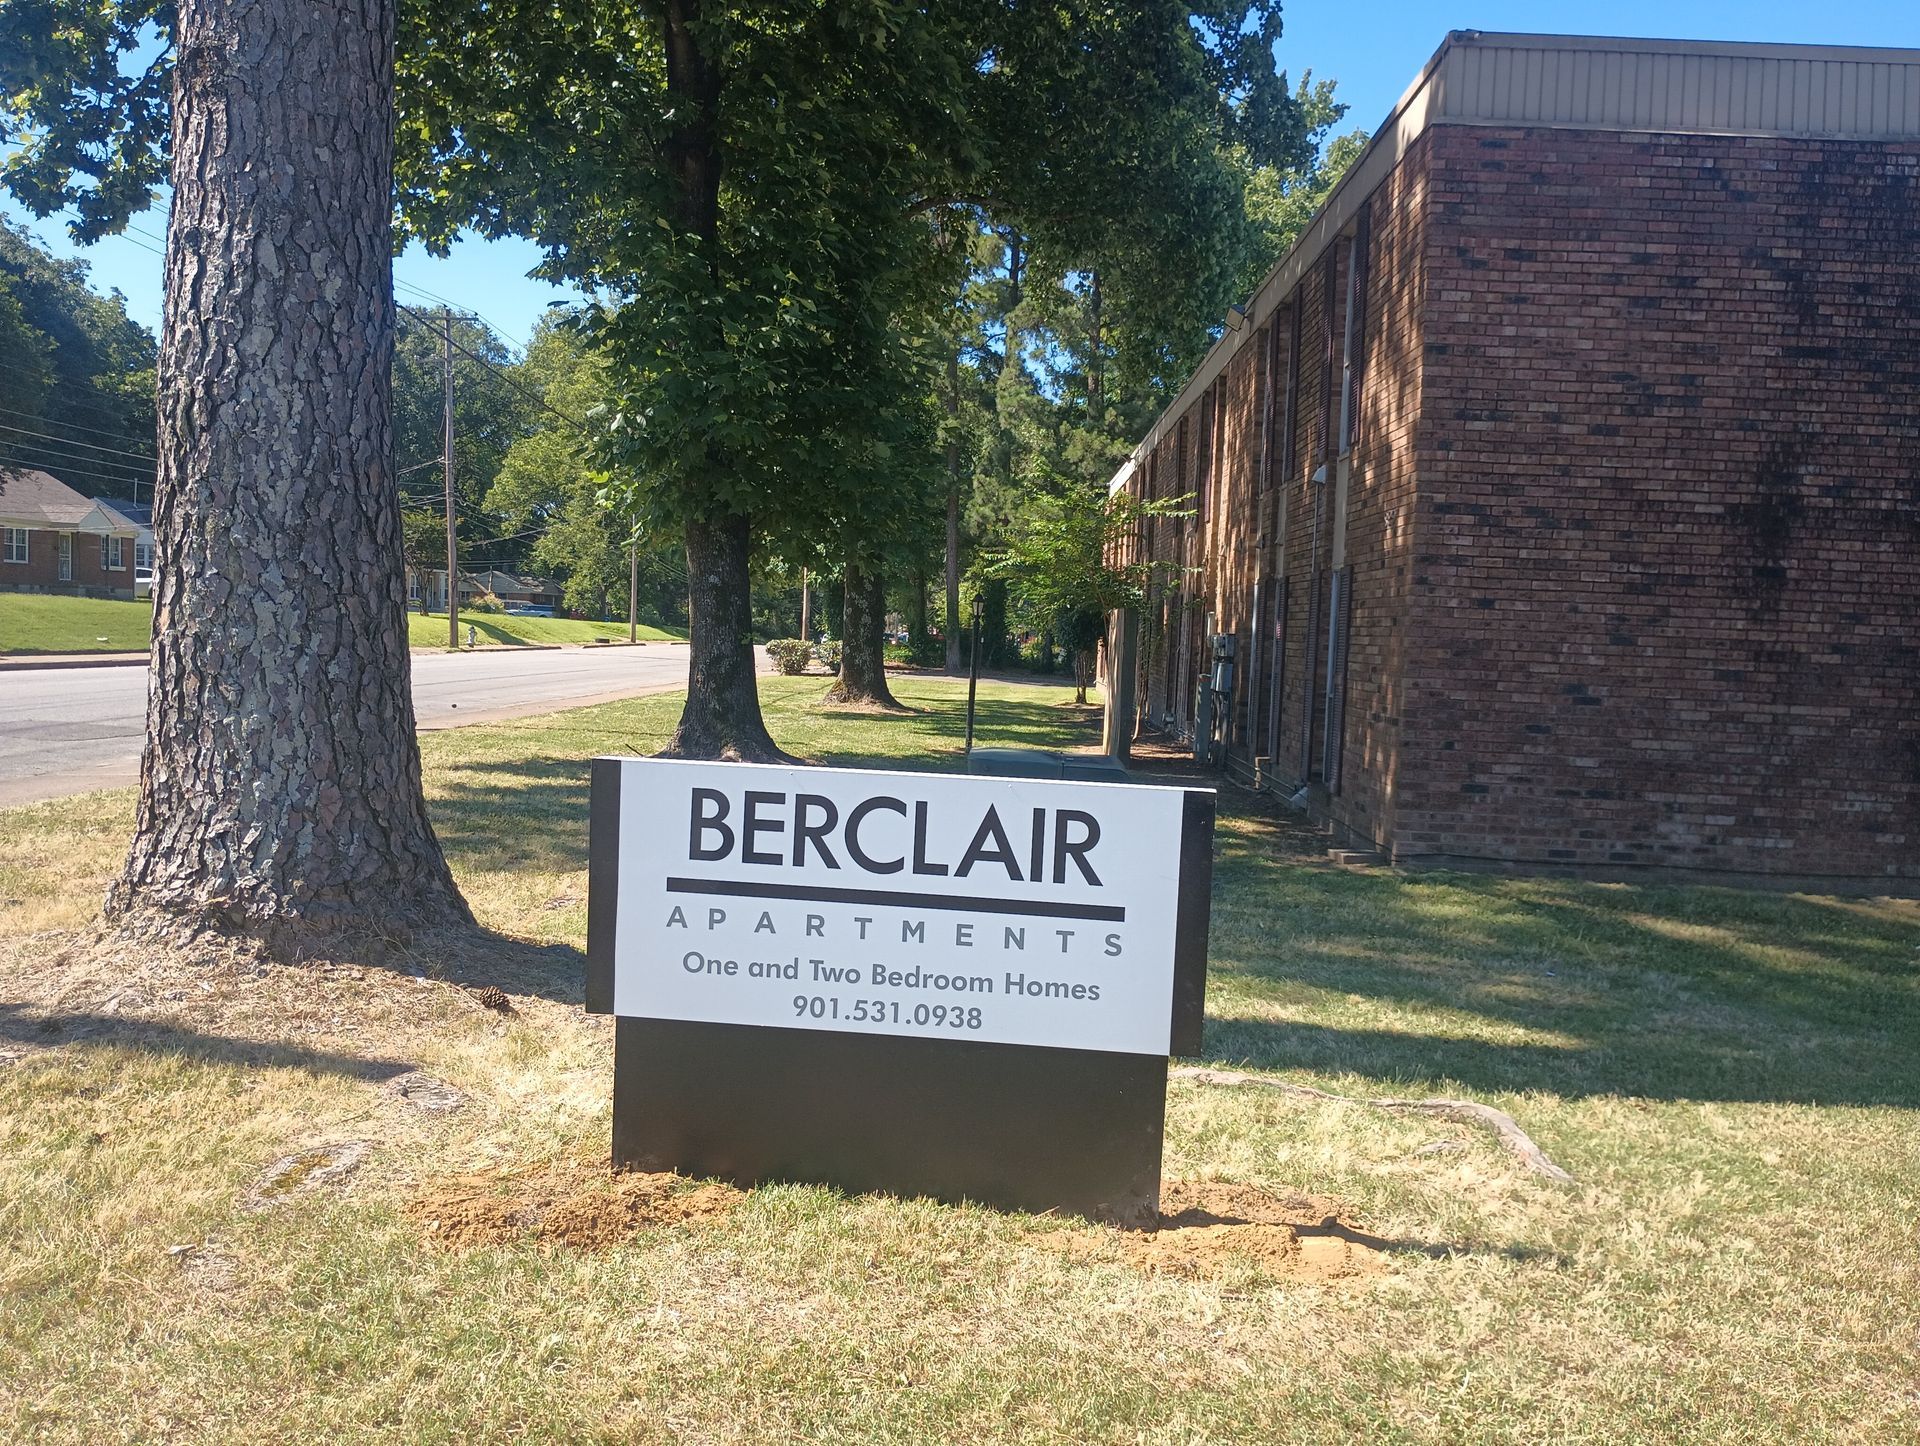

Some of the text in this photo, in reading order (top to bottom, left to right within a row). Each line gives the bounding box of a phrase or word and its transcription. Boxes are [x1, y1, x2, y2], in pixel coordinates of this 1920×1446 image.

[689, 788, 1103, 887] BERCLAIR
[666, 906, 1122, 956] APARTMENTS
[683, 952, 1099, 1000] One and Two Bedroom Homes
[793, 996, 982, 1029] 901.531.0938
